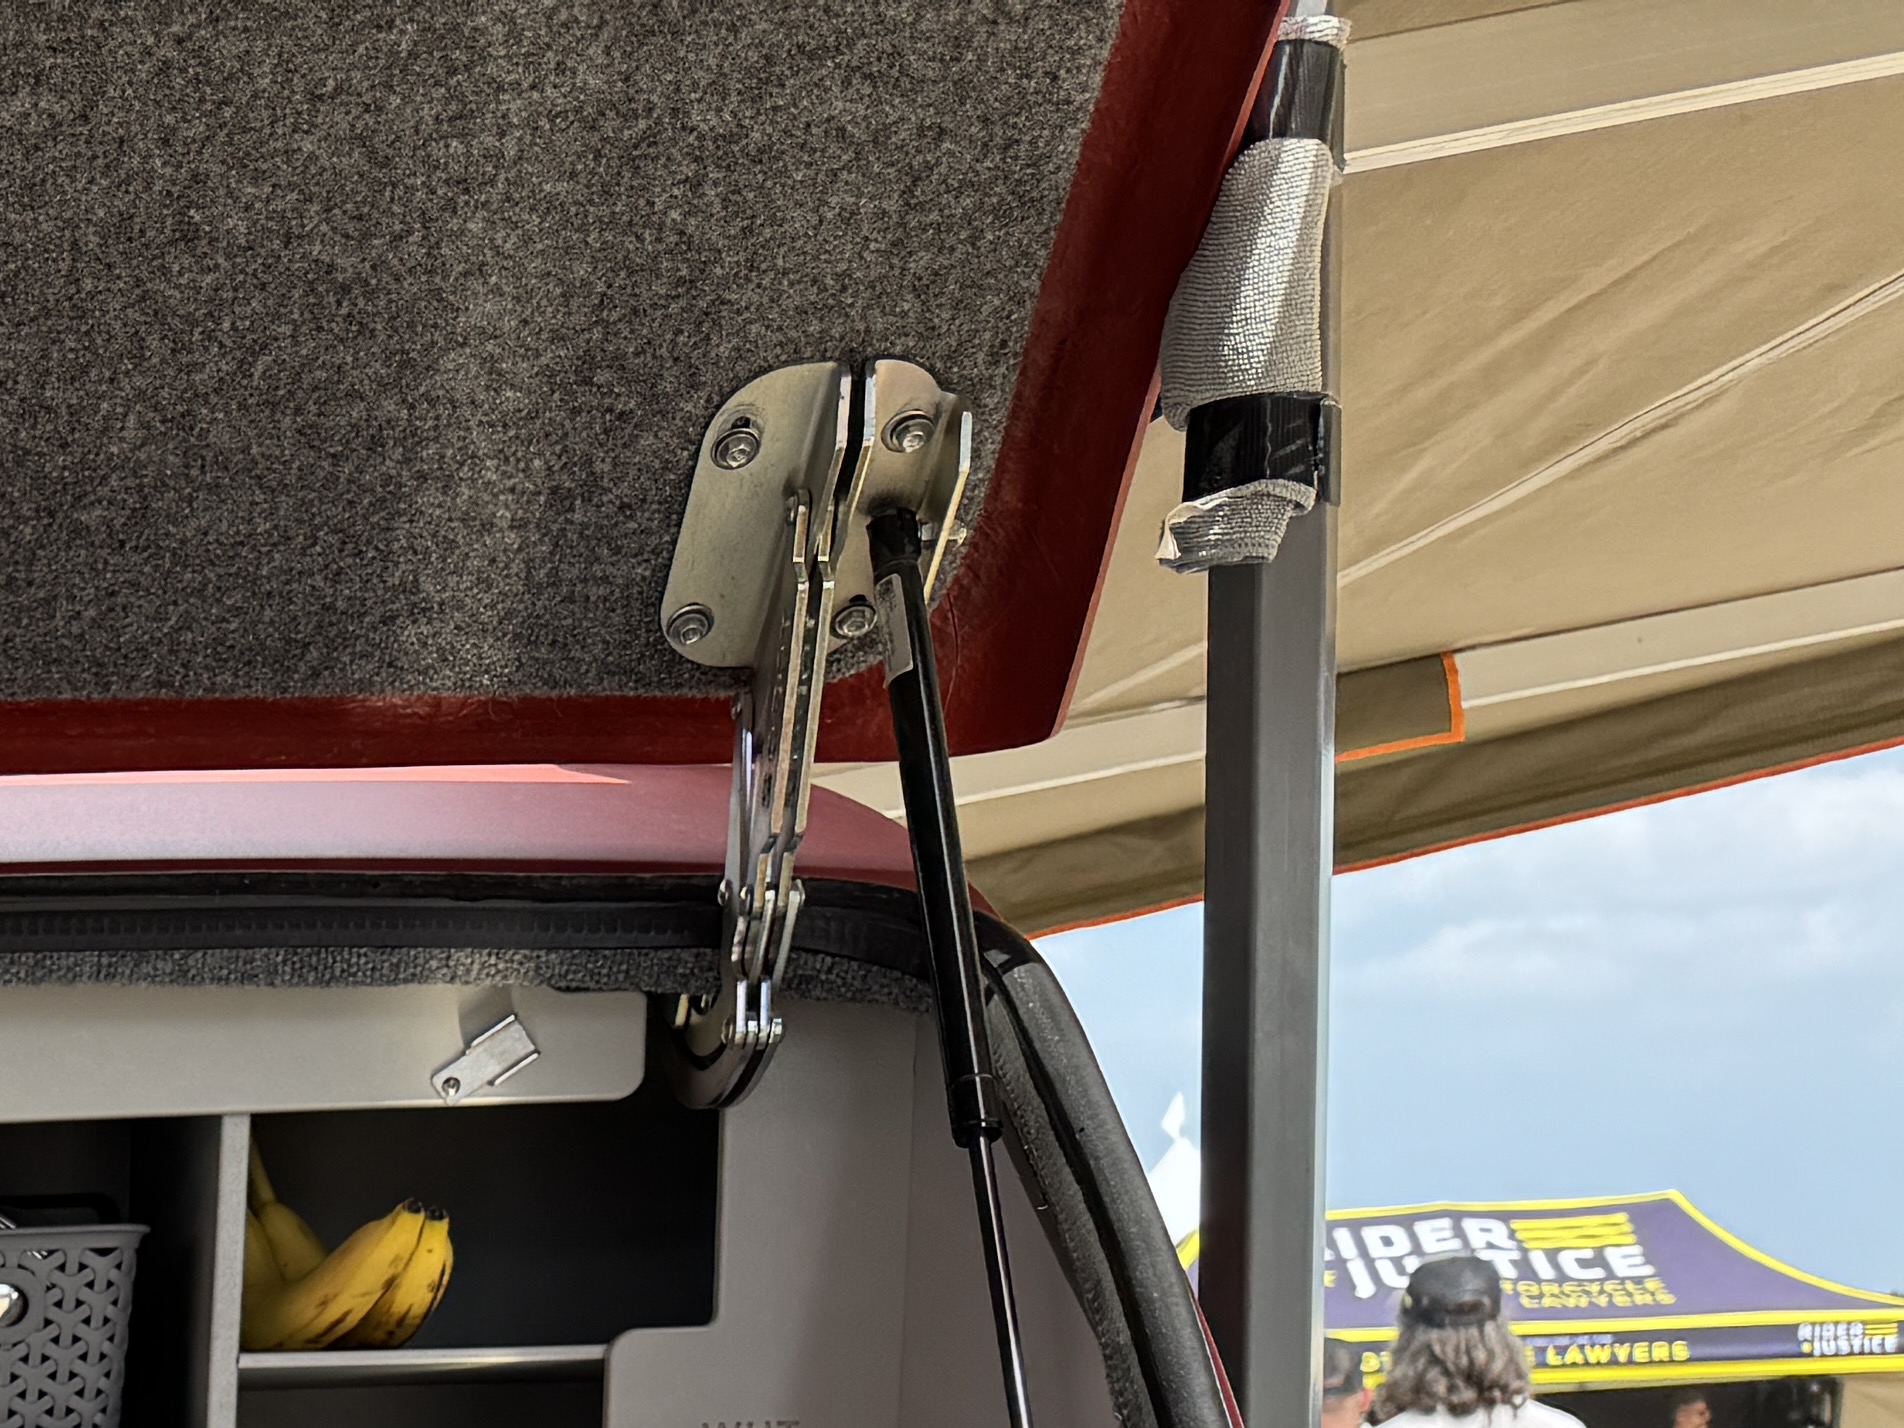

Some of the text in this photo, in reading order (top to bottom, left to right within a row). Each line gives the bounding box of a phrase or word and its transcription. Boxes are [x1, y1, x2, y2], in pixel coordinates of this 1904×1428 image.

[1324, 1217, 1518, 1261] IDER
[1346, 1244, 1656, 1299] JUTICE
[1546, 1341, 1691, 1366] LAWYERS
[1813, 1334, 1897, 1357] JUSTICE
